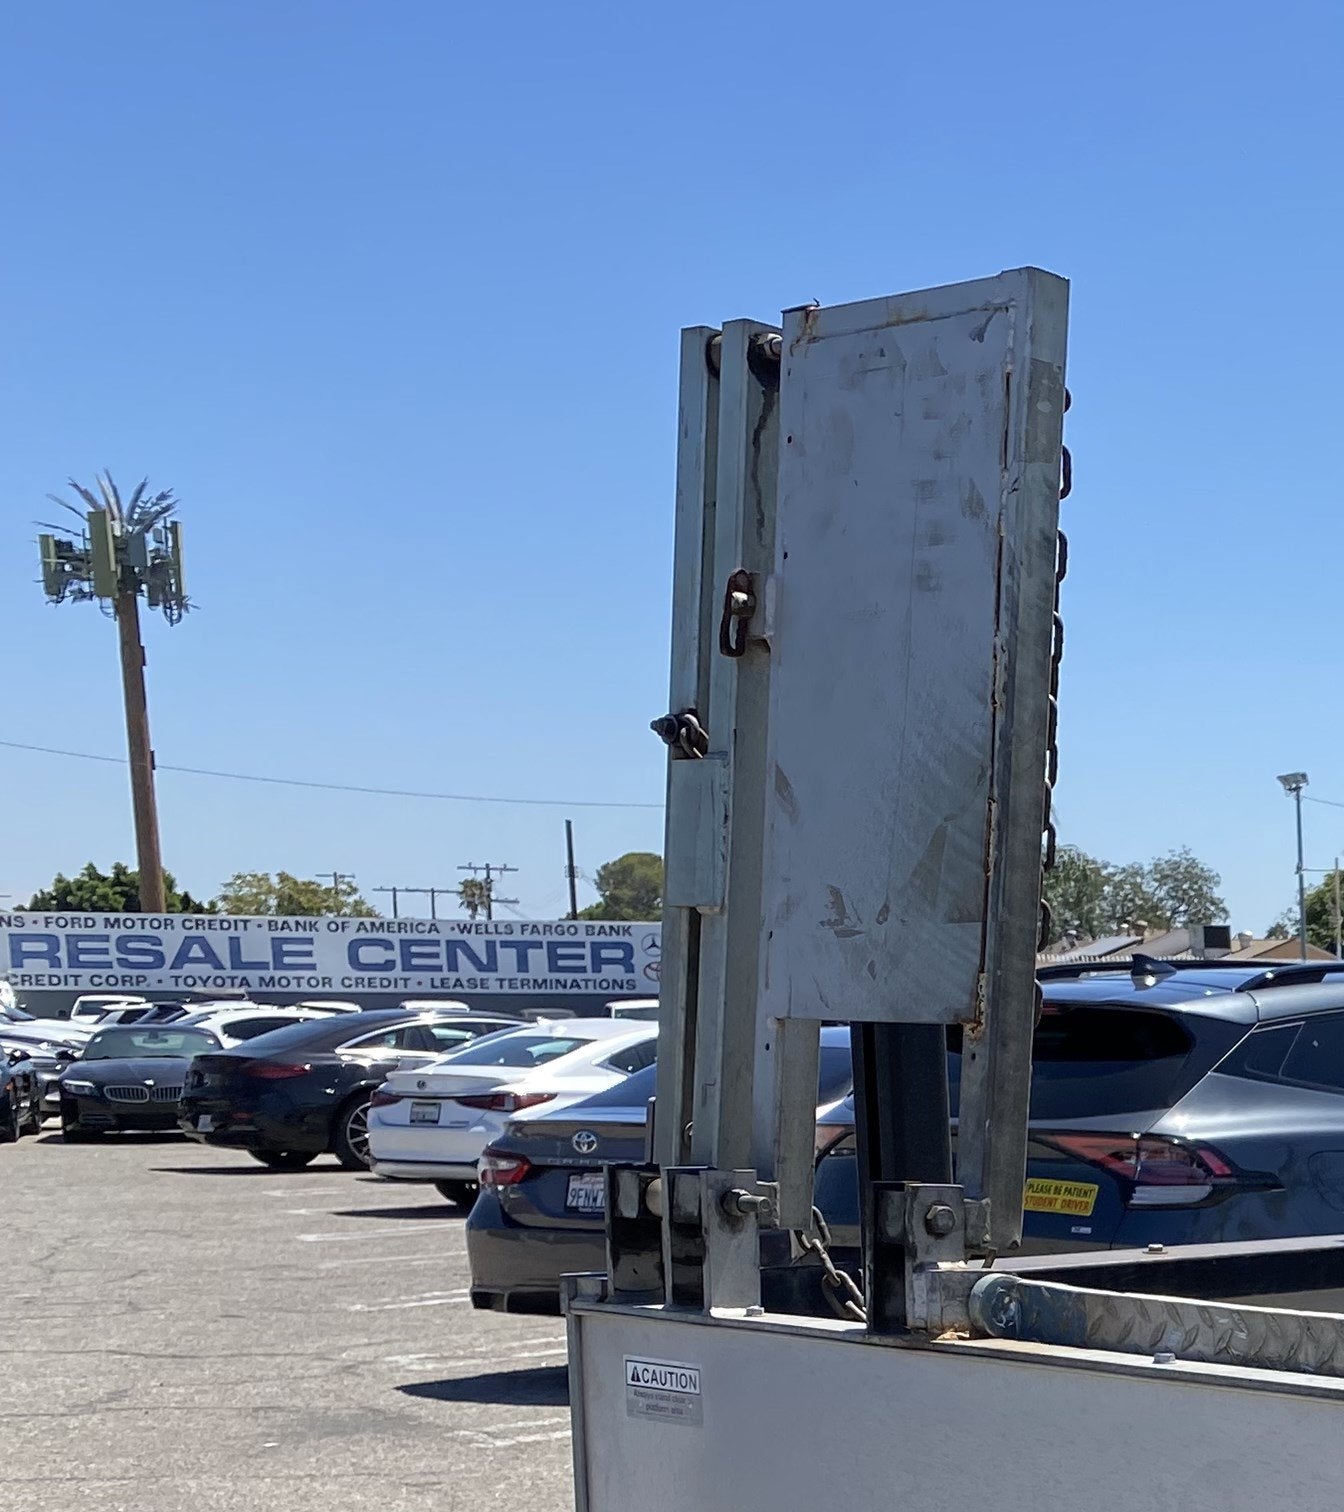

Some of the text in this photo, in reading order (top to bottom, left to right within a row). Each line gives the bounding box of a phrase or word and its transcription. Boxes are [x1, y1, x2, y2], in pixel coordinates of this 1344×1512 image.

[44, 916, 96, 929] FORD
[104, 917, 175, 930] MOTOR
[182, 919, 250, 931] CREDIT
[267, 920, 319, 932] BANK
[326, 921, 348, 933] OF
[356, 921, 440, 934] AMERICA
[456, 923, 514, 935] WELLS
[520, 924, 578, 936] FARGO
[586, 924, 632, 937] BANK
[8, 933, 635, 973] RESALE CENTER
[6, 974, 637, 991] CREDIT CORP. TOYOTA MOTOR CREDIT LEASE TERMINATIONS
[1027, 1183, 1094, 1199] PLEASE BE PATIENT
[1024, 1195, 1090, 1211] STUDENT DRIVER
[642, 1367, 697, 1390] CAUTION
